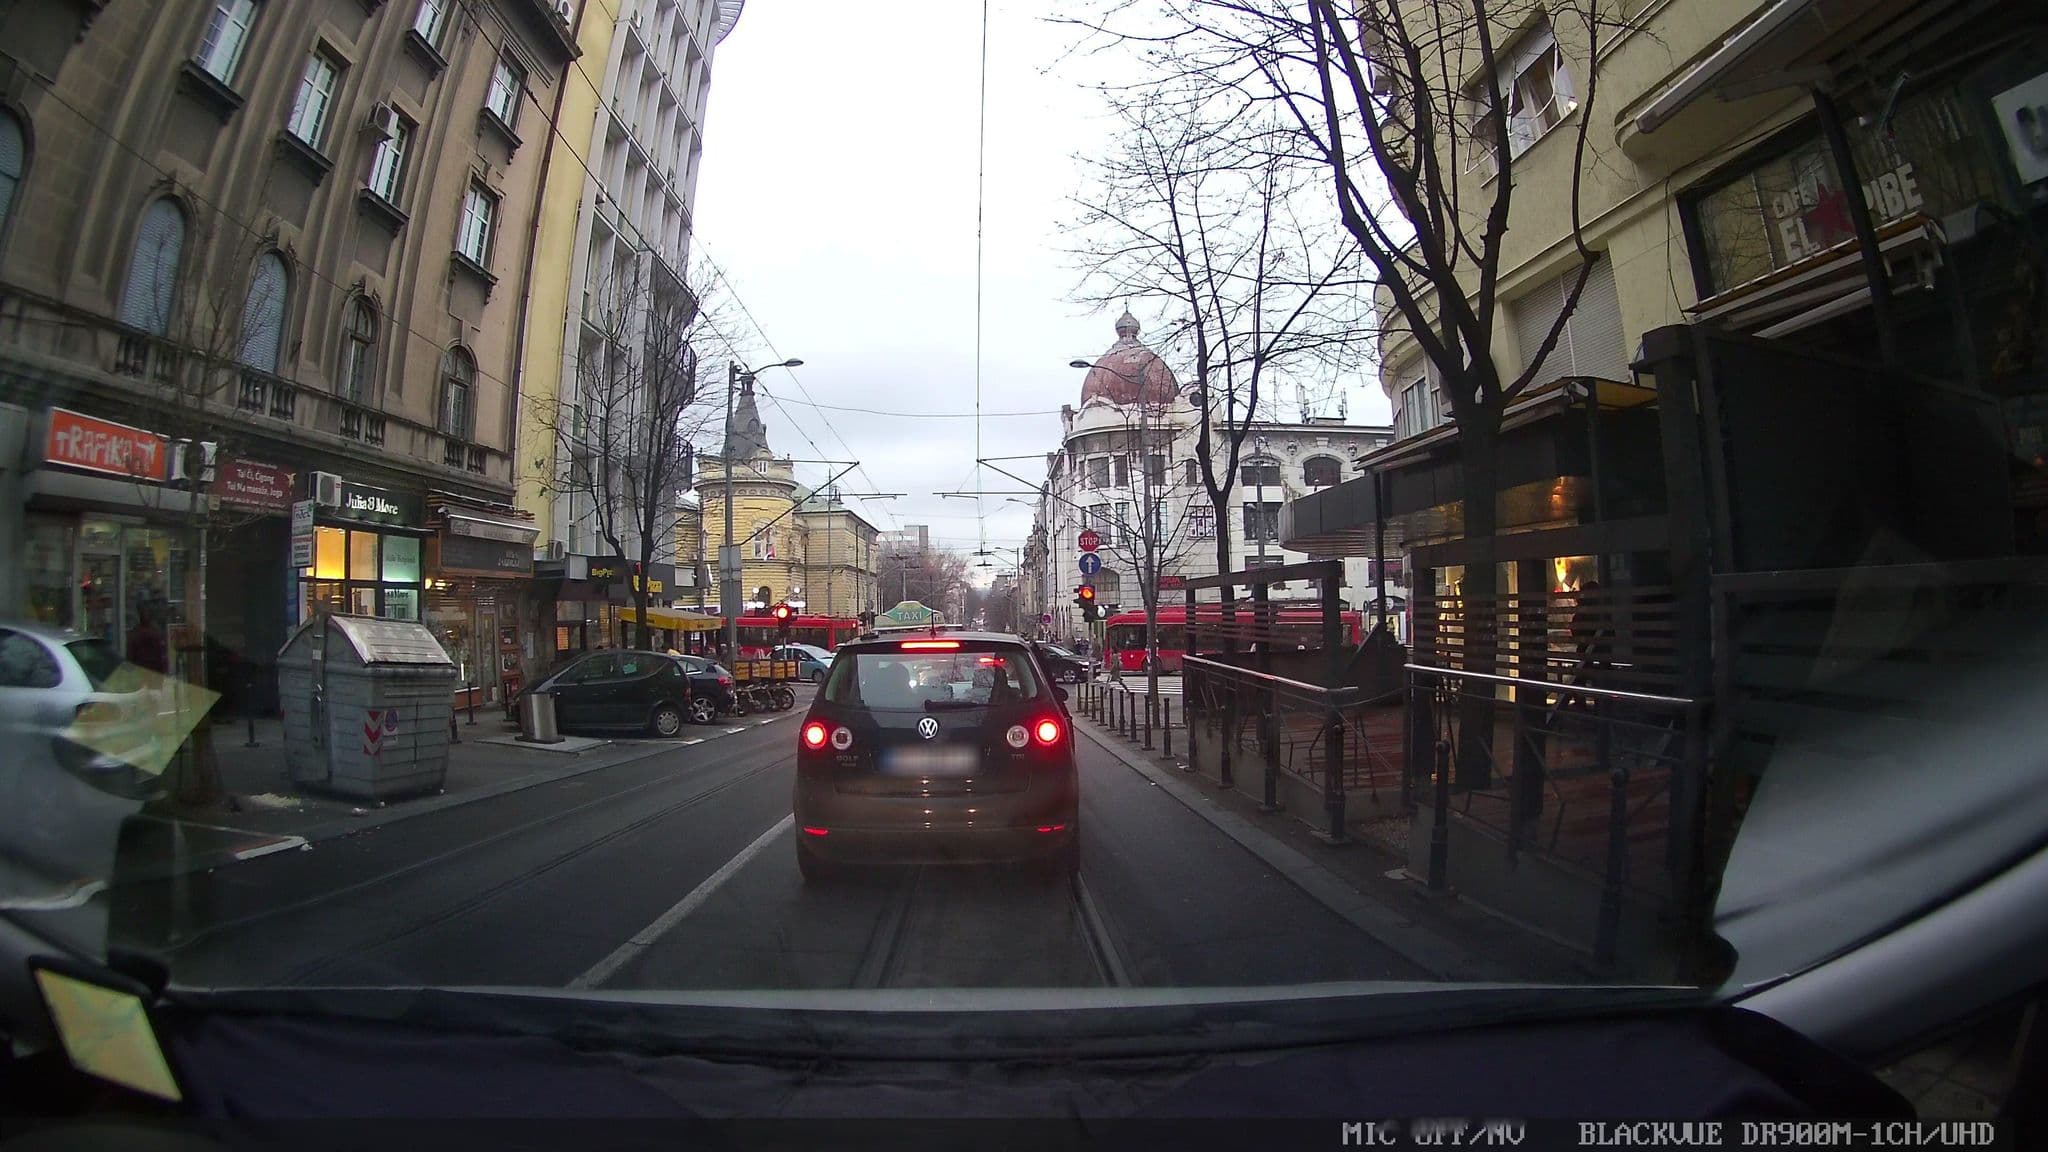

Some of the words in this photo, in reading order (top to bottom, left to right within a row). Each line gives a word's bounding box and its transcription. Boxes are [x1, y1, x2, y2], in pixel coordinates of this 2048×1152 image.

[374, 497, 399, 515] More
[1080, 537, 1098, 546] STOP
[896, 611, 923, 621] TAXI
